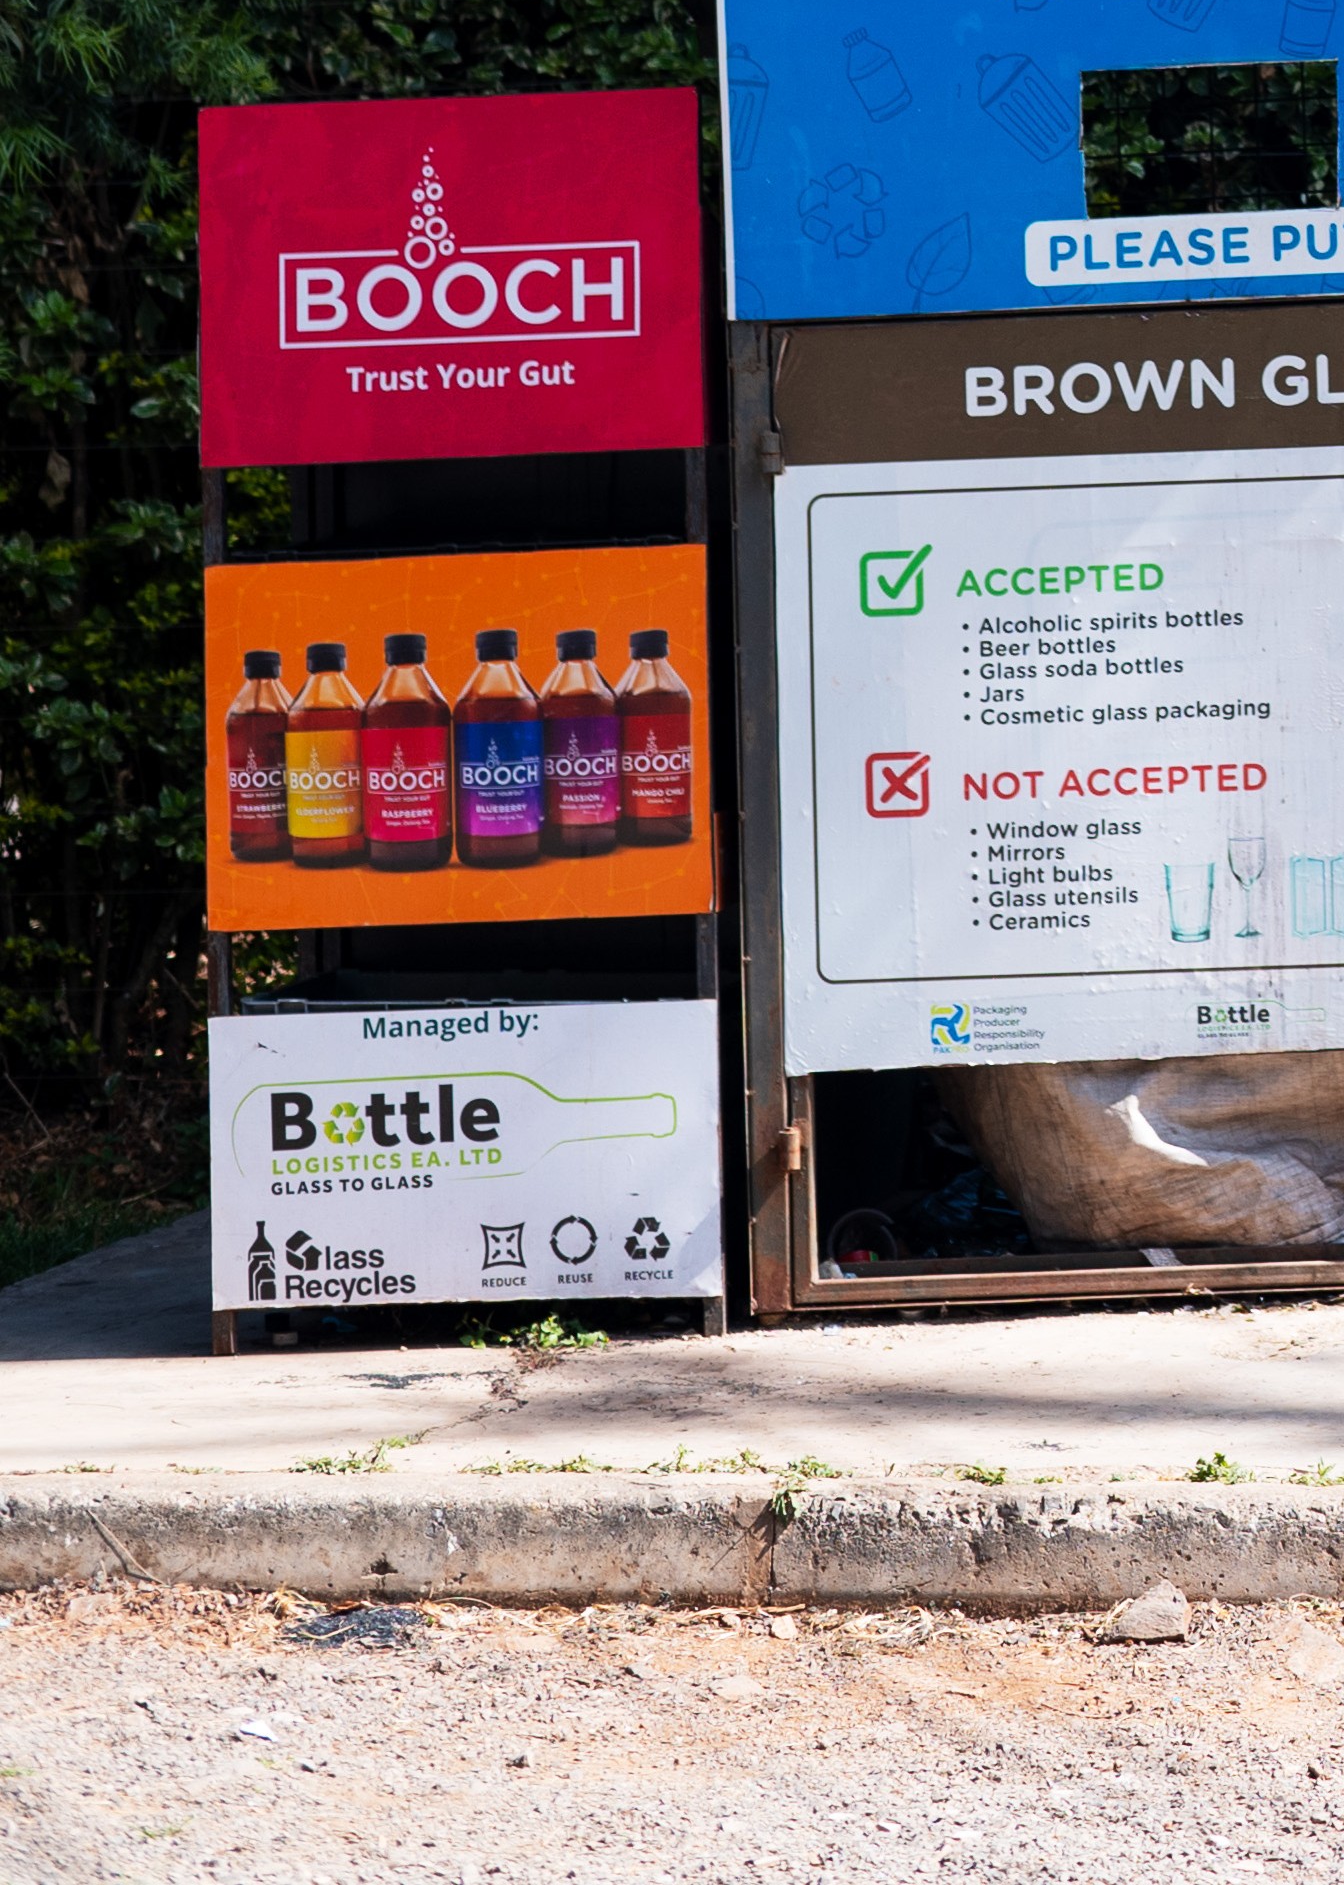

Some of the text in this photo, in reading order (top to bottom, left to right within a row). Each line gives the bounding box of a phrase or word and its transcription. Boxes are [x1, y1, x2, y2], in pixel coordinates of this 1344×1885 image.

[1048, 225, 1250, 272] PLEASE
[295, 256, 624, 333] BOOCH
[346, 360, 575, 393] Trust Your Gut
[965, 357, 1235, 417] BROWN
[956, 563, 1164, 598] ACCEPTED
[979, 608, 1244, 635] Alcoholic spirits bottles
[980, 635, 1116, 657] Beer bottles
[980, 656, 1184, 681] Glass soda bottles
[980, 685, 1025, 704] Jars
[980, 698, 1271, 726] Cosmetic glass packaging
[545, 757, 616, 777] BOOCH
[622, 753, 691, 772] BOOCH
[290, 770, 360, 790] BOOCH
[369, 770, 445, 791] BOOCH
[462, 764, 539, 785] BOOCH
[964, 762, 1267, 801] NOT ACCEPTED
[987, 818, 1141, 840] Window glass
[988, 844, 1066, 862] Mirrors
[988, 864, 1113, 887] Light bulbs
[988, 886, 1139, 909] Glass utensils
[989, 912, 1090, 931] Ceramics
[973, 1004, 1027, 1017] Packaging
[363, 1010, 539, 1042] Managed by:
[973, 1017, 1020, 1028] Producer
[973, 1028, 1045, 1042] Responsibility
[973, 1040, 1040, 1052] Organisation
[272, 1149, 502, 1175] LOGISTICS EA. LTD
[271, 1175, 434, 1196] GLASS TO GLASS
[481, 1276, 527, 1288] REDUCE
[558, 1273, 594, 1285] REUSE
[625, 1269, 674, 1281] RECYCLE
[285, 1271, 416, 1303] Recycles
